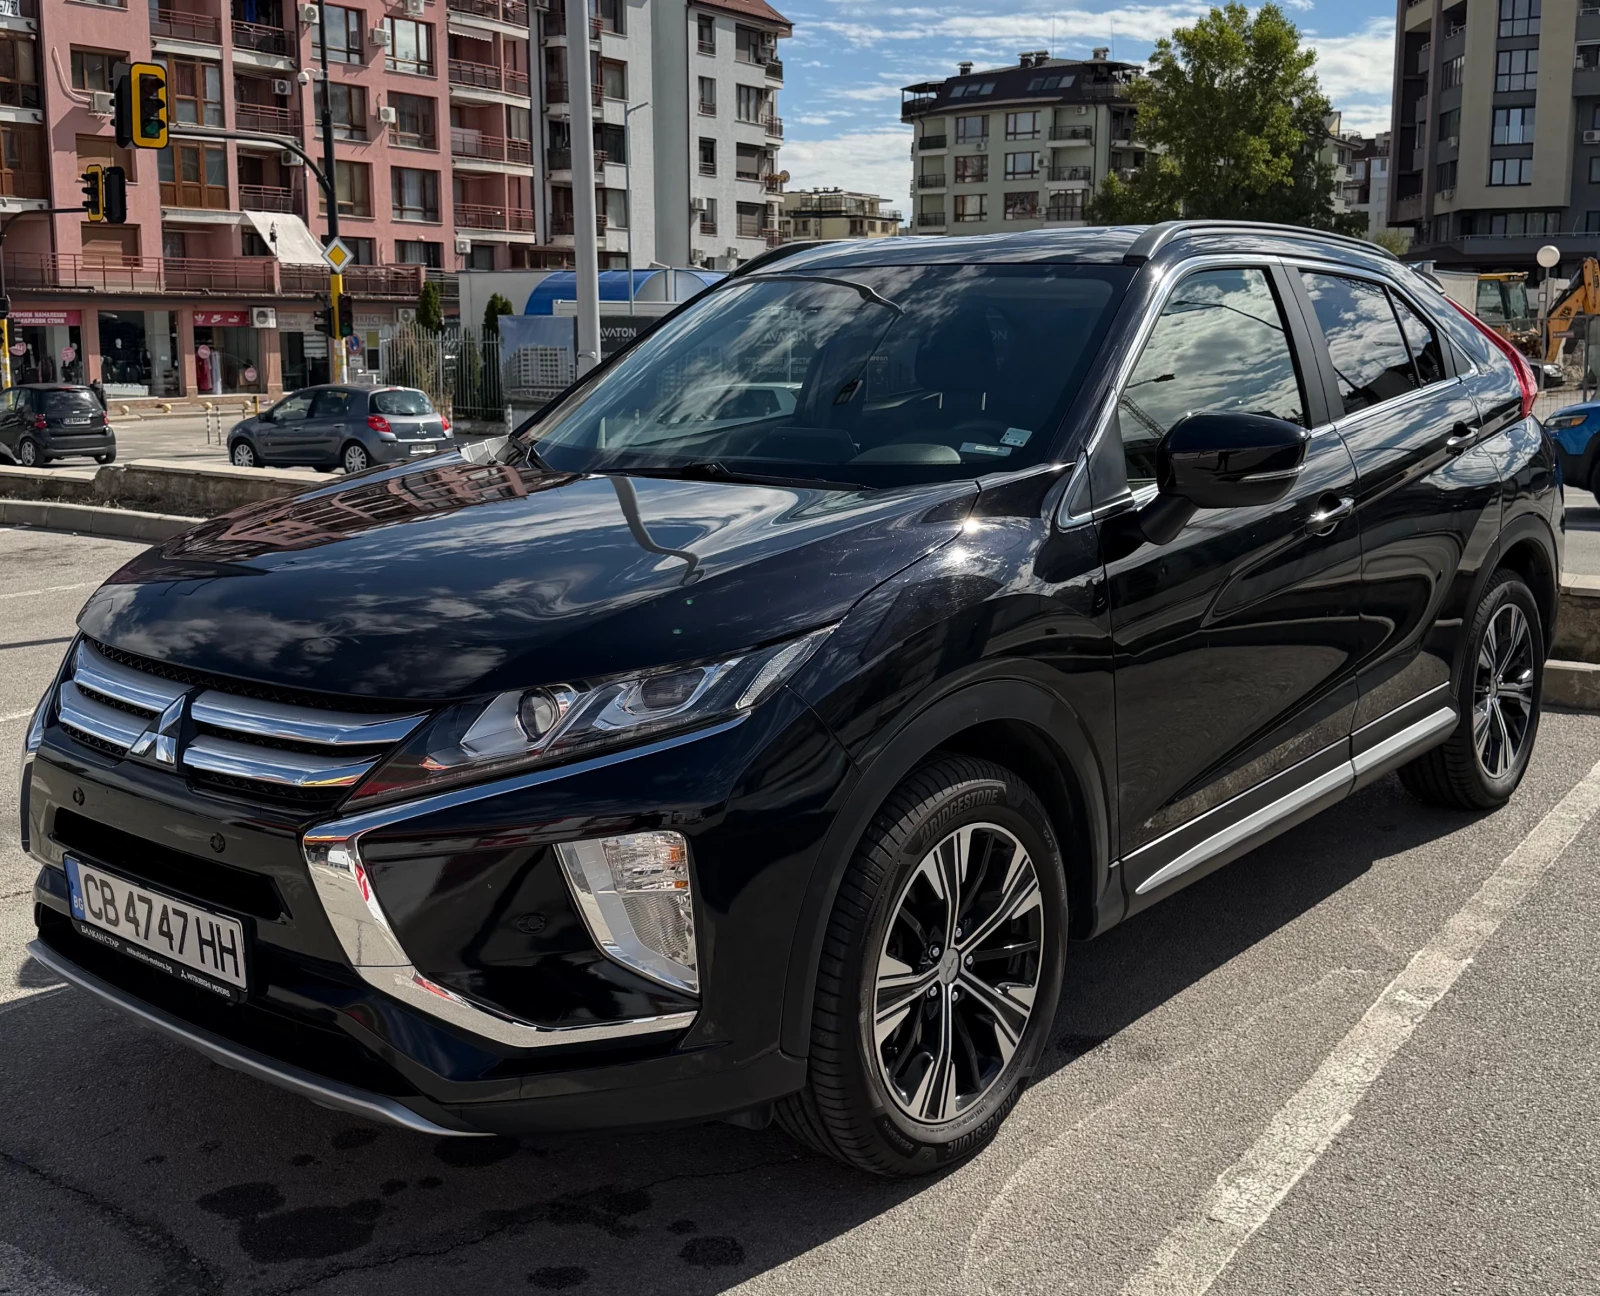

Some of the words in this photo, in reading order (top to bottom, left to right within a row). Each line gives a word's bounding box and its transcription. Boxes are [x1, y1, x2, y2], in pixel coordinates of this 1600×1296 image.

[919, 789, 999, 846] BRIDGESTONE
[73, 895, 84, 911] BG
[186, 972, 212, 989] MITSUBISHI
[211, 983, 231, 997] MOTORS
